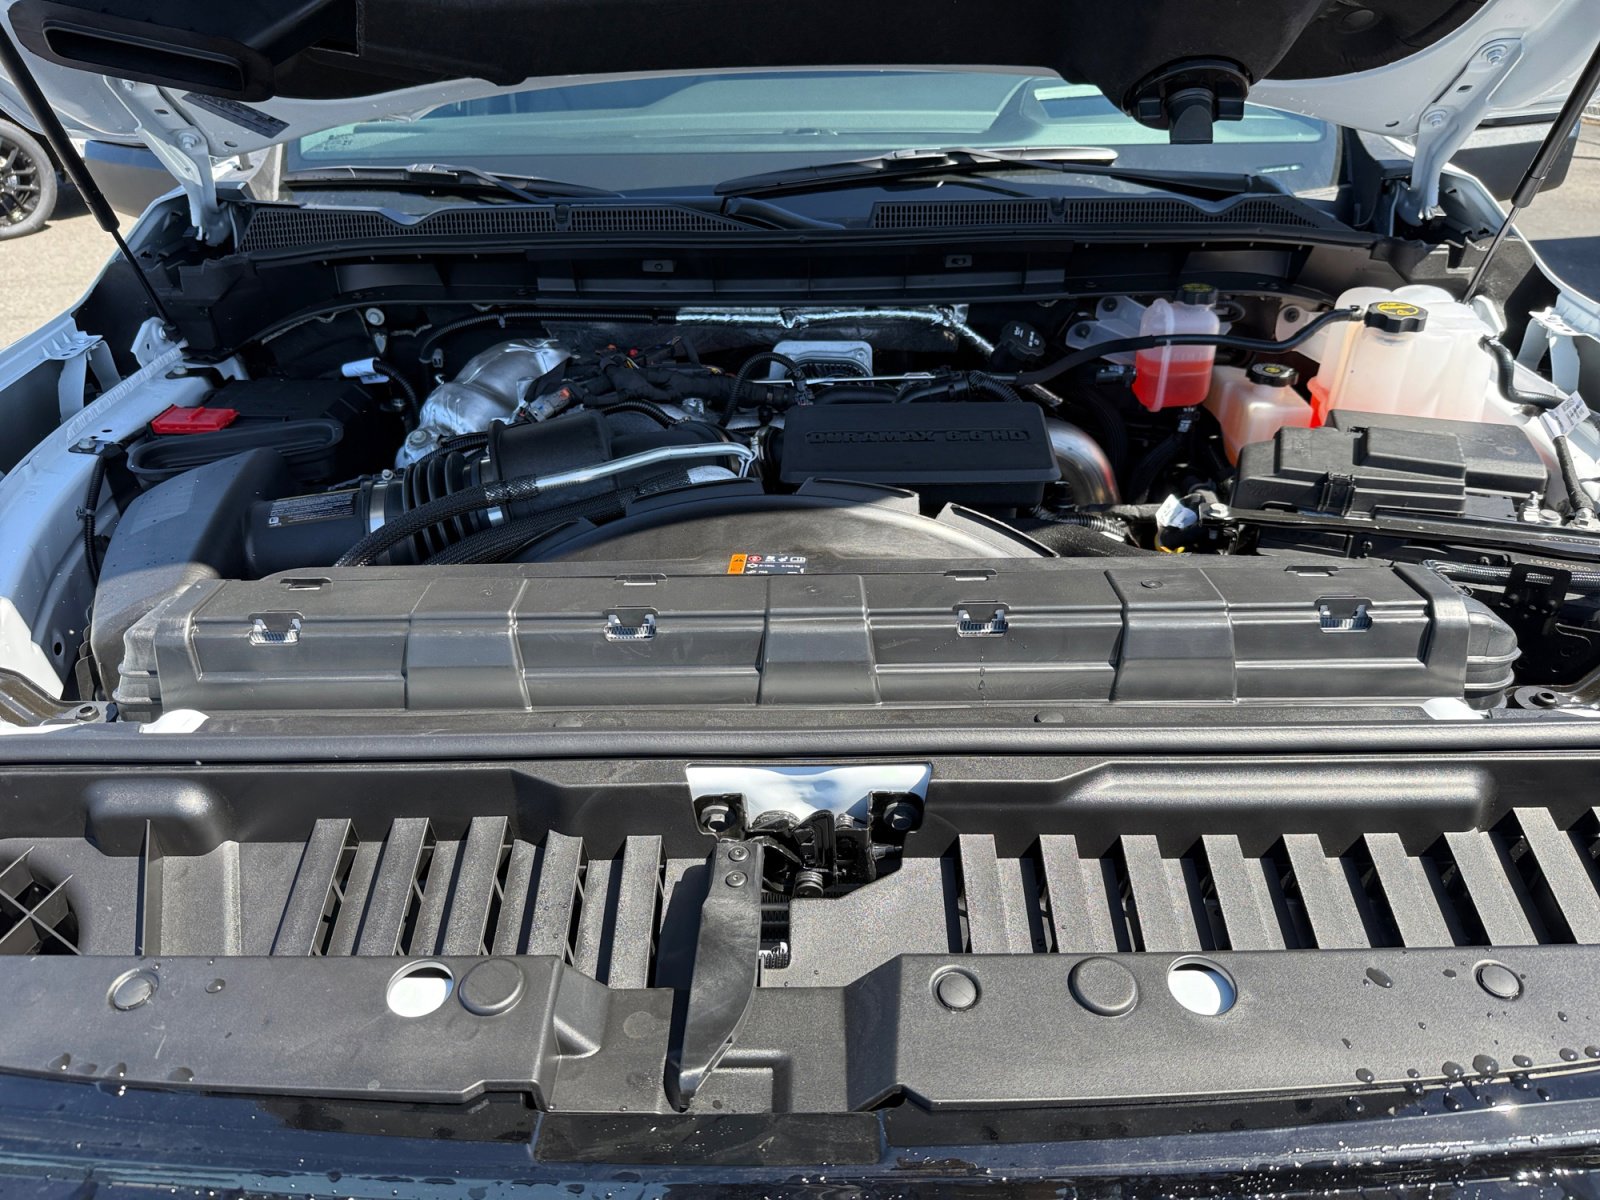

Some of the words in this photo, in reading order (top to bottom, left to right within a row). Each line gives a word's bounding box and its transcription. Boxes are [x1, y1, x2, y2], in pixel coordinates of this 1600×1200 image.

[808, 431, 936, 443] DURAMAX
[944, 430, 984, 442] 6.6
[989, 430, 1028, 442] HD
